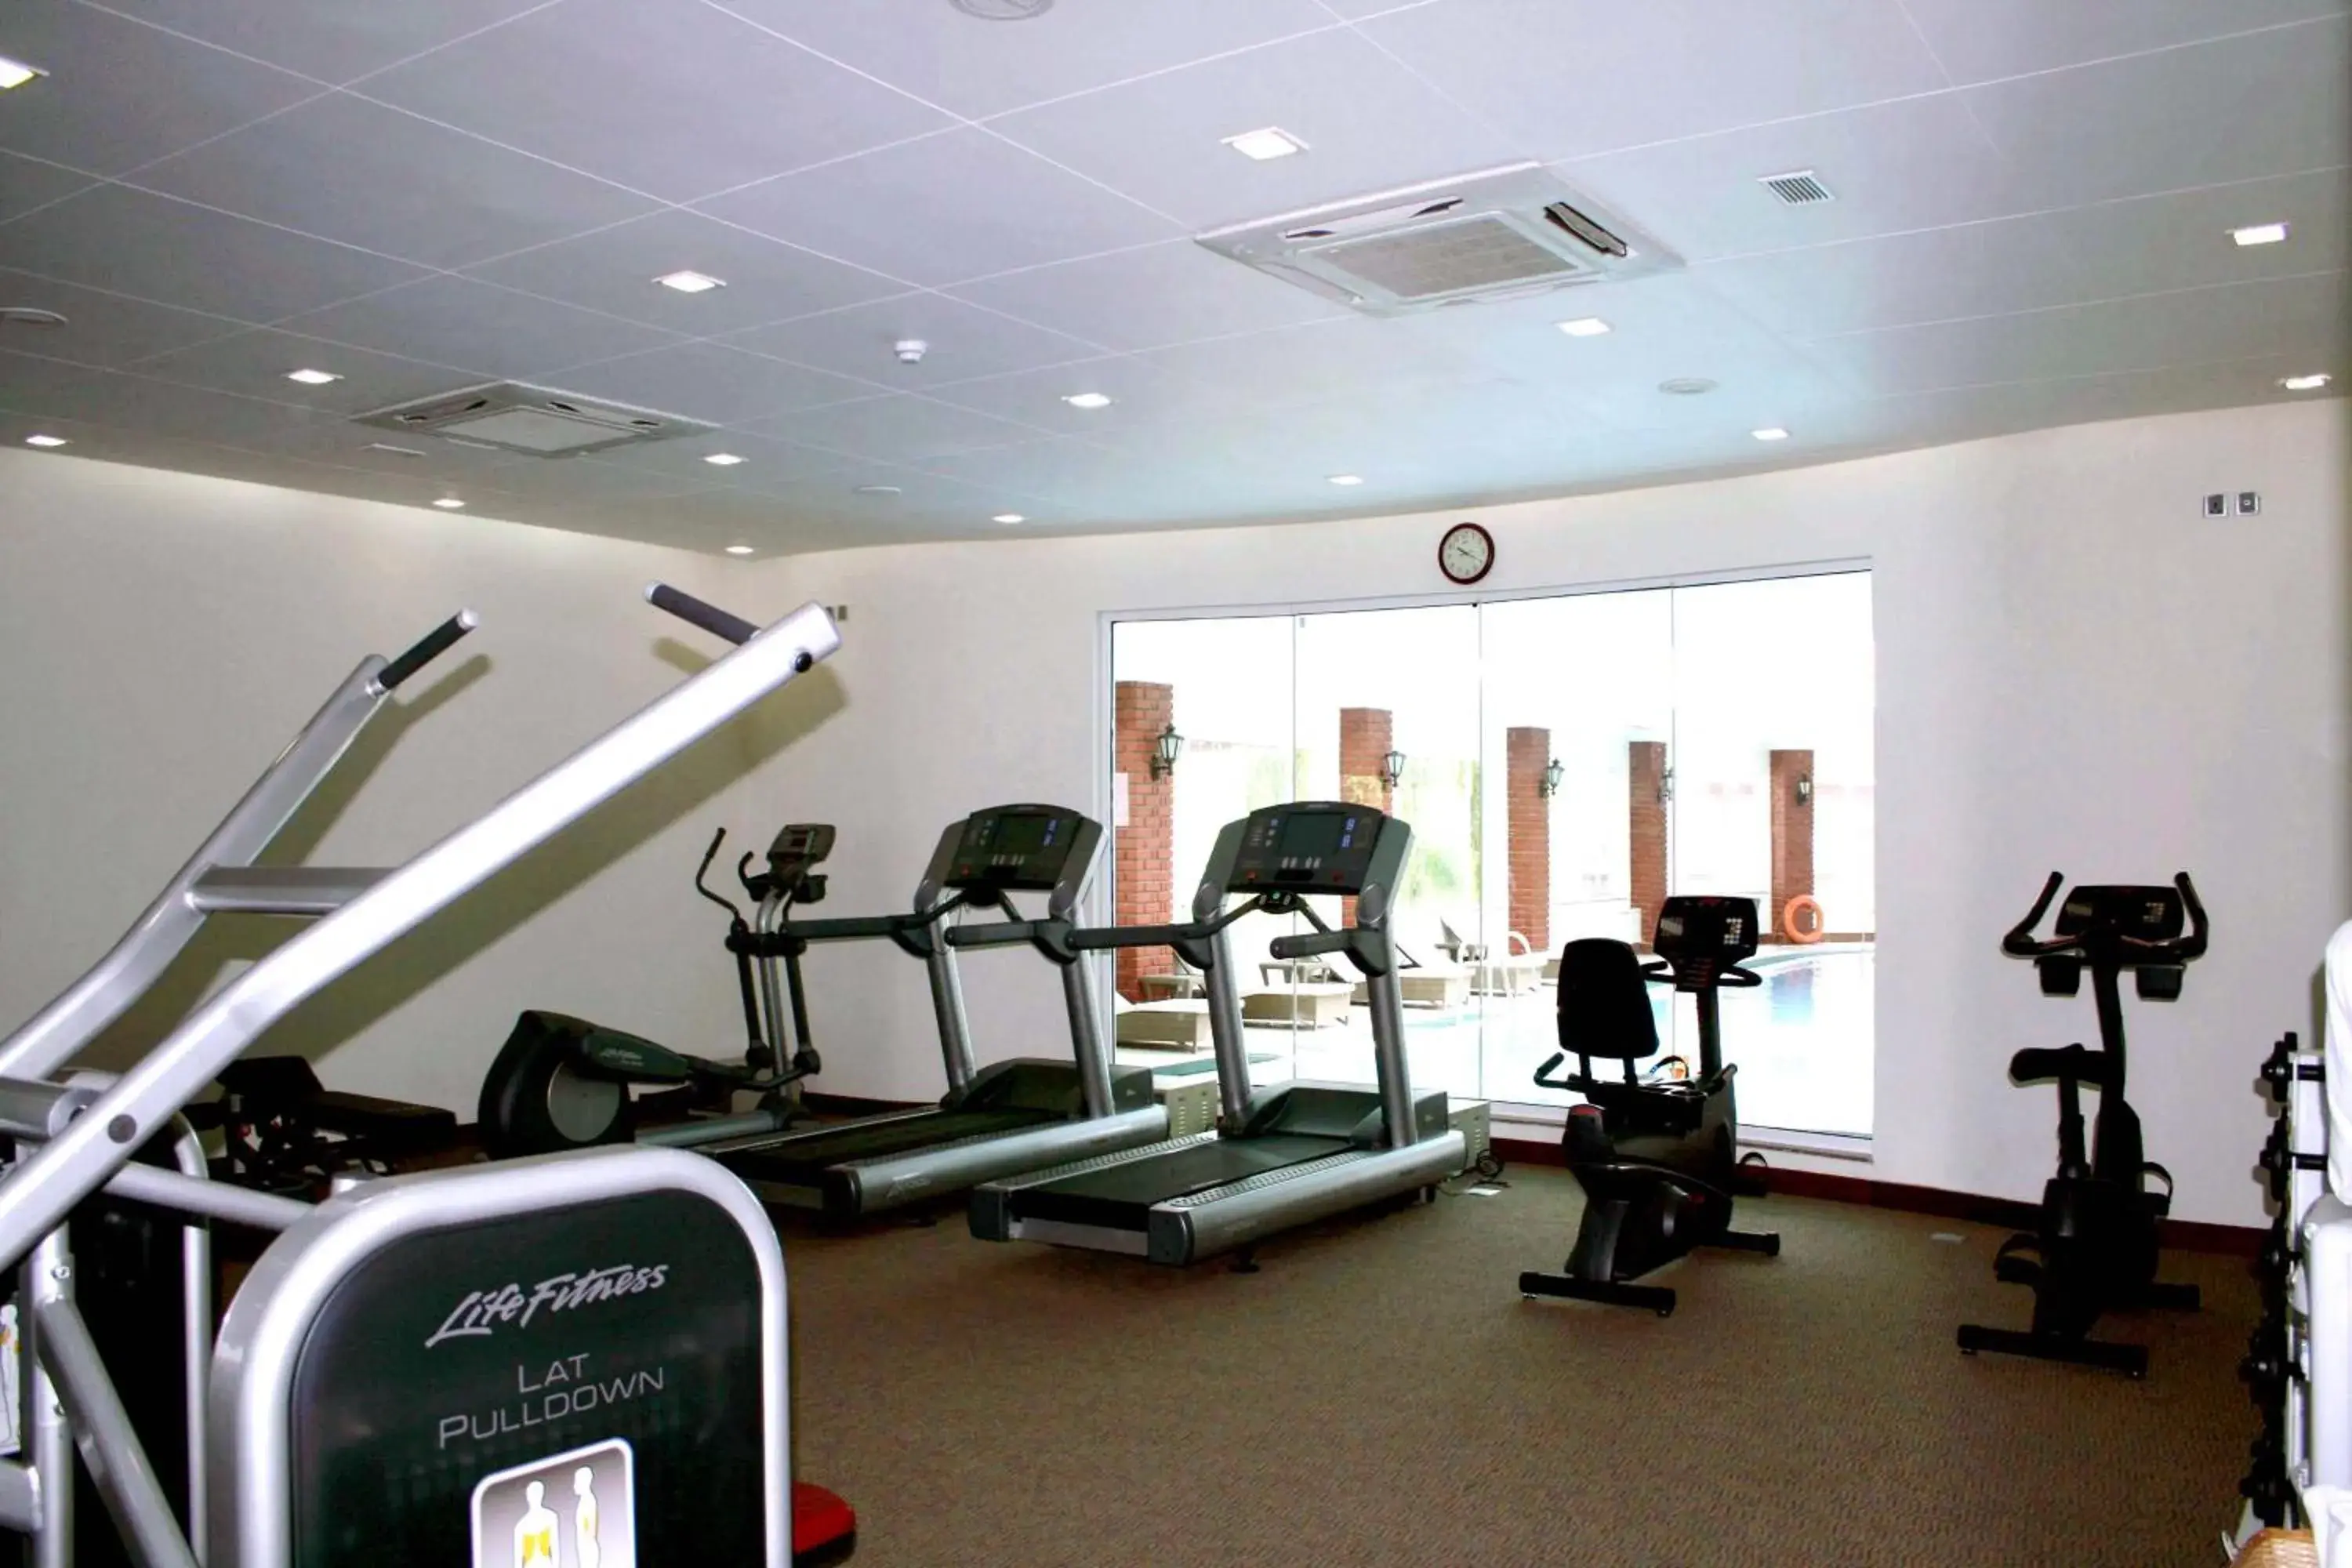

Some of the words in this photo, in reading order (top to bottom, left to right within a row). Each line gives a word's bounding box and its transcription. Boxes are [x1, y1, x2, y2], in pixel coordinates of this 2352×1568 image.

[425, 1283, 524, 1348] Life
[520, 1265, 669, 1328] Fitness
[440, 1367, 664, 1449] PULLDOWN
[517, 1353, 590, 1394] LAT
